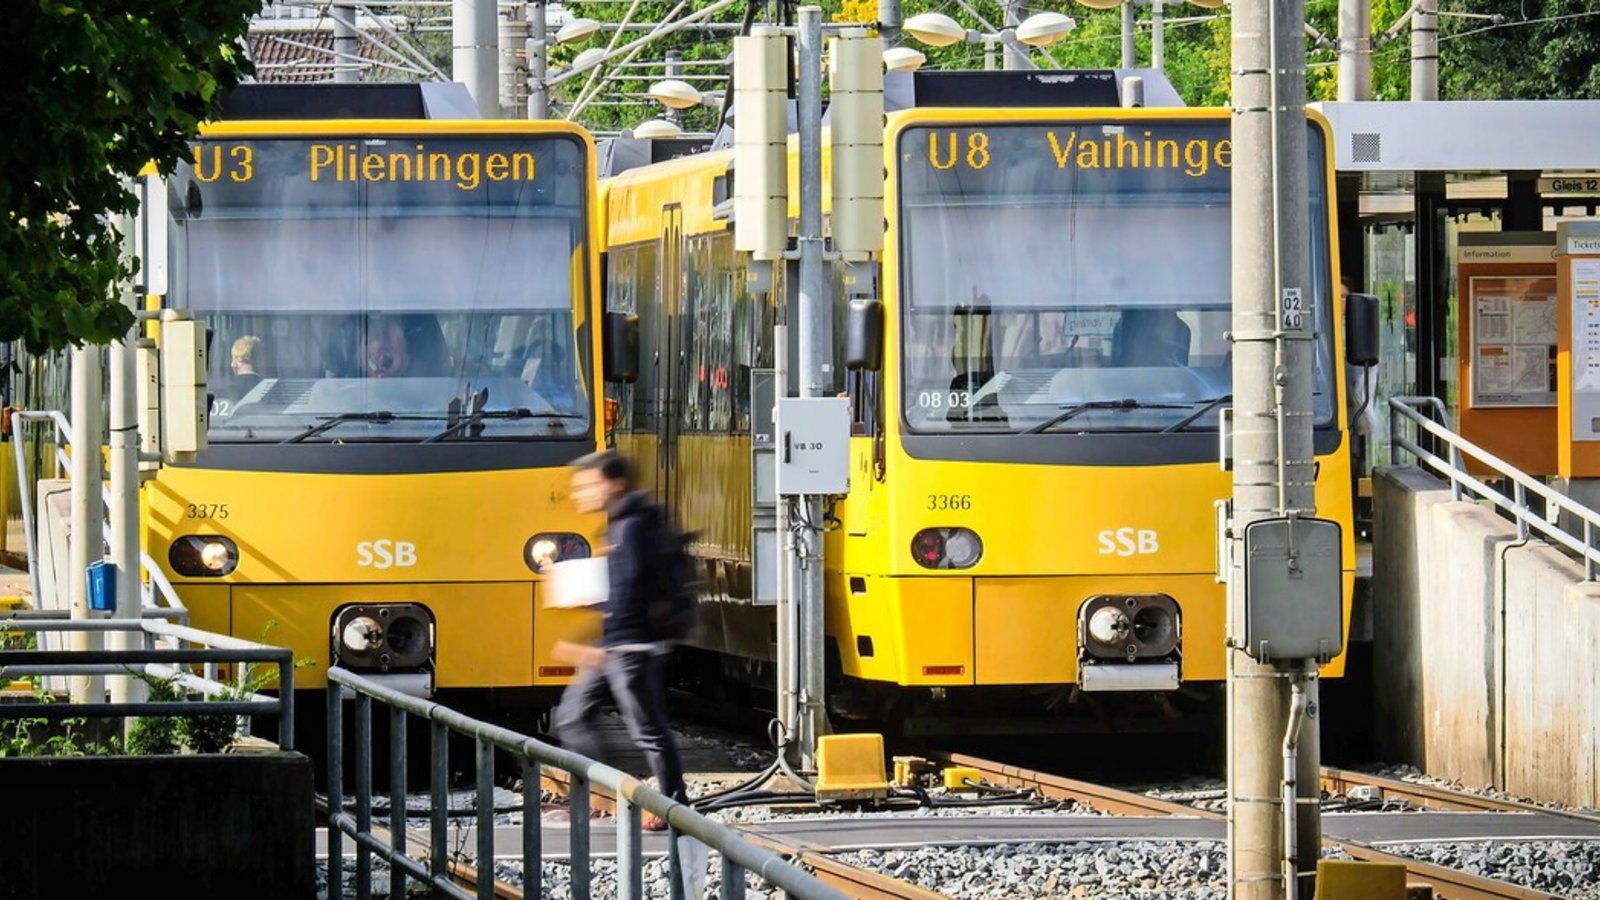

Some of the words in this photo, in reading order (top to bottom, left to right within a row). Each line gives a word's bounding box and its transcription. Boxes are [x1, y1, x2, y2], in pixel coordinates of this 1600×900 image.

[309, 144, 535, 190] Plieningen
[1552, 180, 1583, 192] Gleis
[1585, 180, 1598, 191] 12
[1464, 250, 1511, 258] Information
[1284, 297, 1300, 310] 02
[1284, 314, 1300, 327] 40
[919, 392, 941, 408] 08
[948, 392, 970, 408] 03
[809, 442, 823, 450] 30
[927, 494, 971, 510] 3366
[187, 503, 229, 519] 3375
[1097, 526, 1159, 557] SSB
[356, 538, 417, 569] SSB
